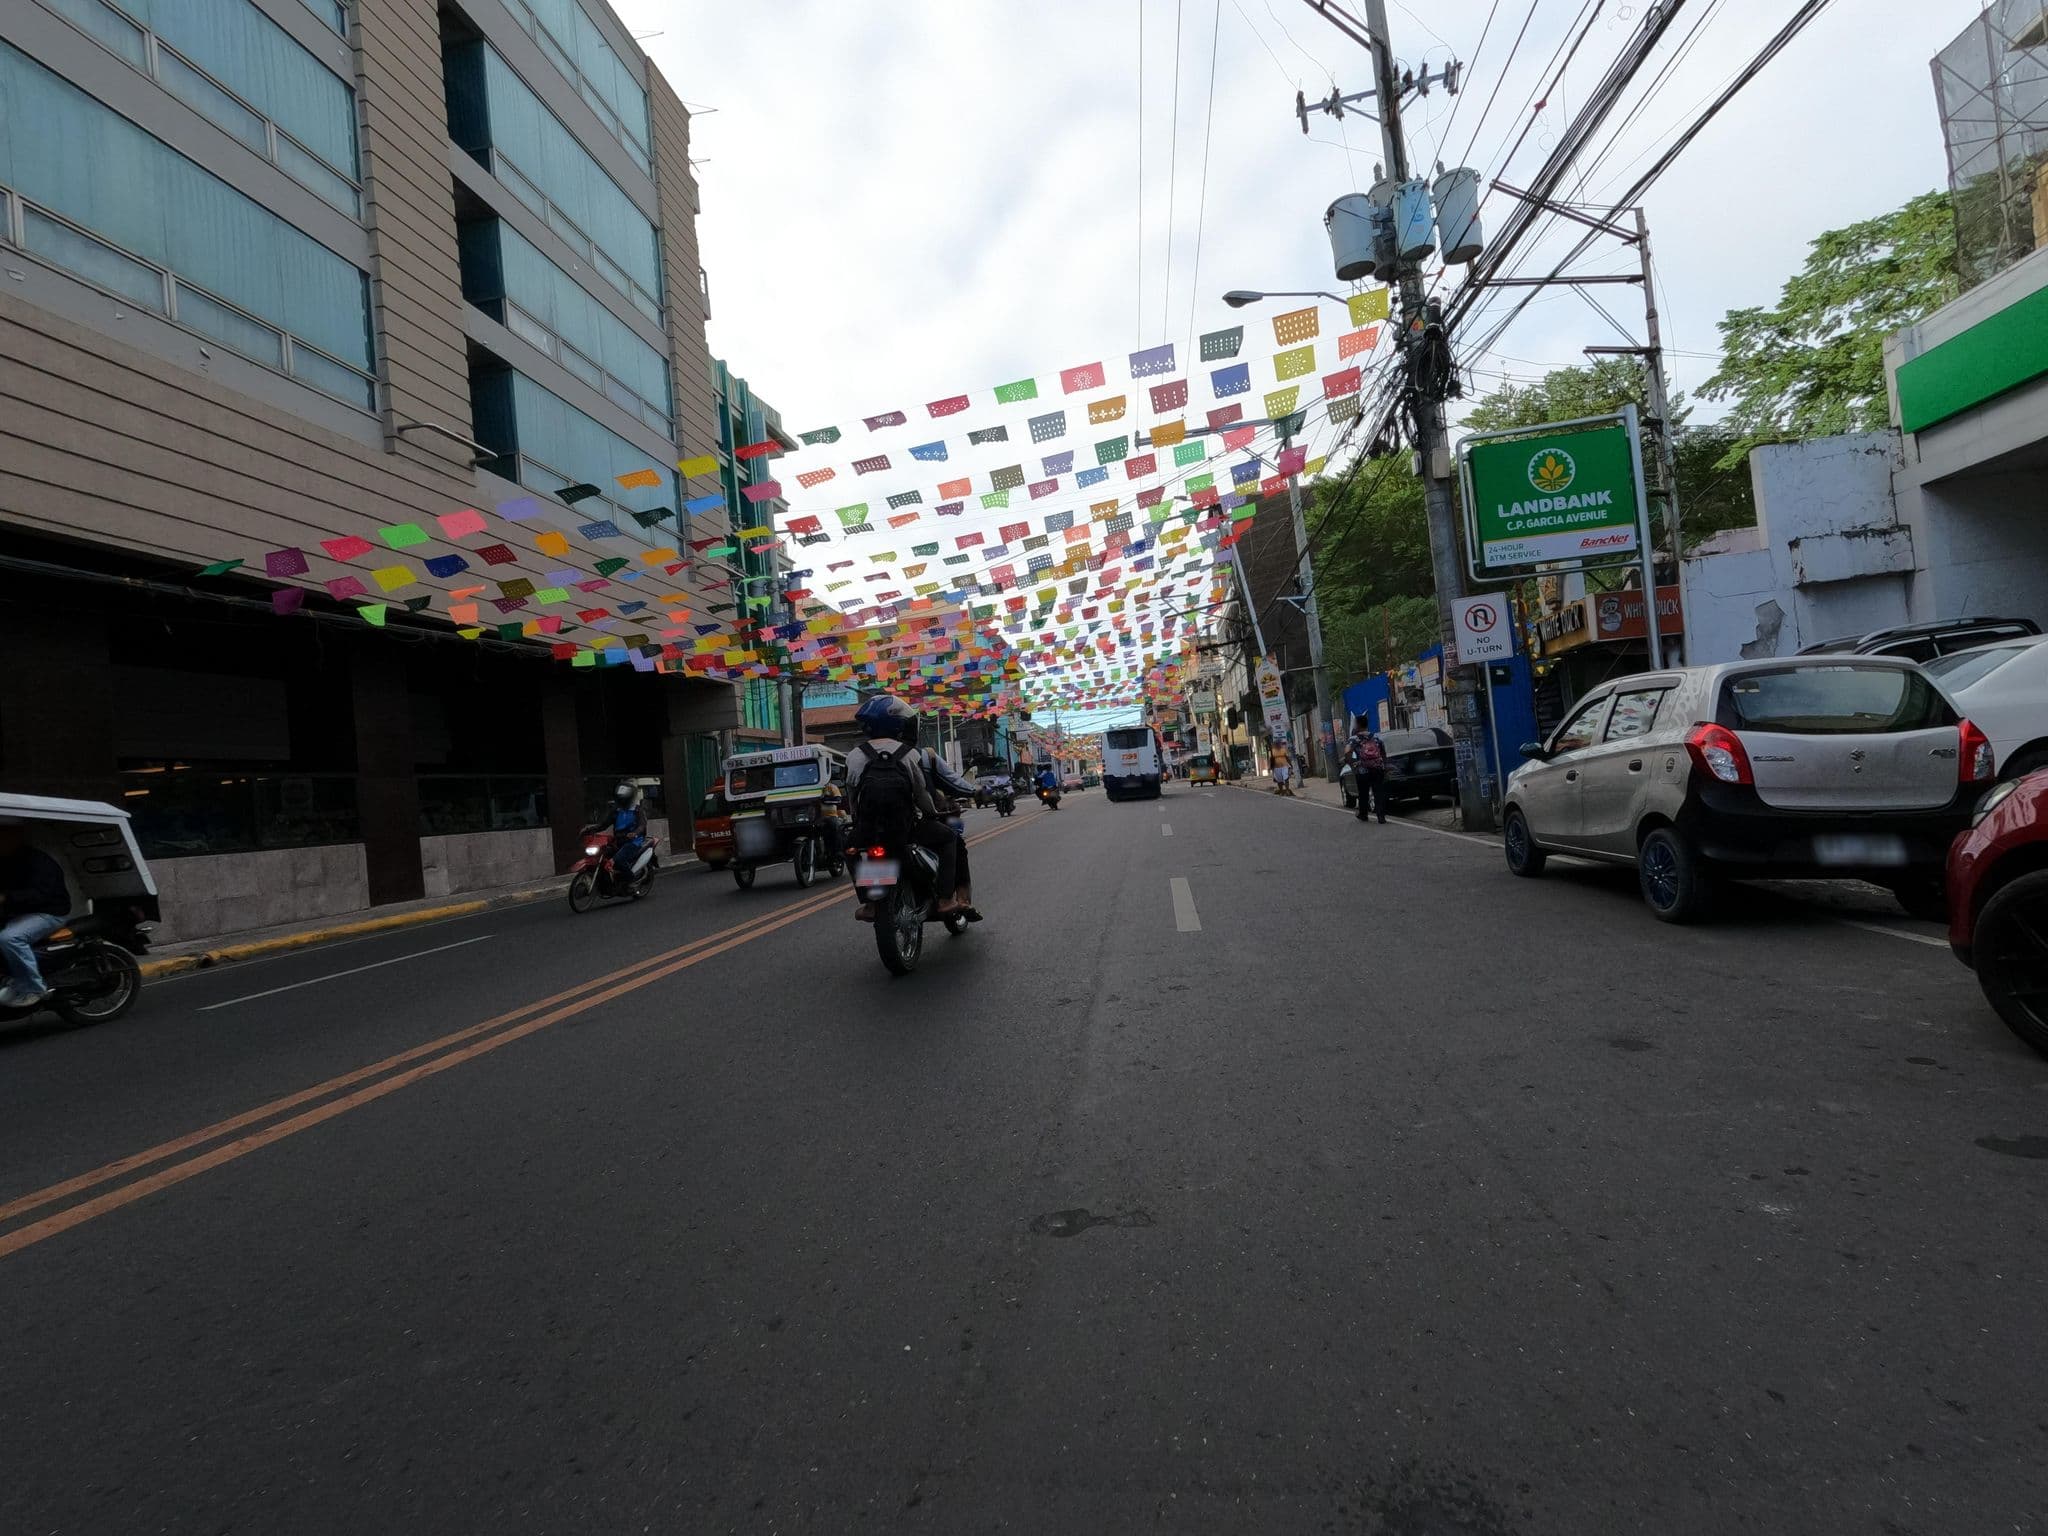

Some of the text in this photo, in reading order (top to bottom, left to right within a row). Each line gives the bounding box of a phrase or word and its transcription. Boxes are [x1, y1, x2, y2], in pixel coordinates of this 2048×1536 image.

[1498, 489, 1613, 518] LANDBANK
[1506, 509, 1608, 531] C.P. GARCIA AVENUE
[1580, 534, 1630, 549] BancNet
[1488, 543, 1524, 554] 24-HOUR
[1489, 550, 1542, 562] ATM SERVICE
[1539, 604, 1581, 641] WHITE DUCK
[1476, 636, 1491, 644] NO
[1466, 644, 1503, 655] U-TURN
[775, 747, 809, 760] FOR HIRE
